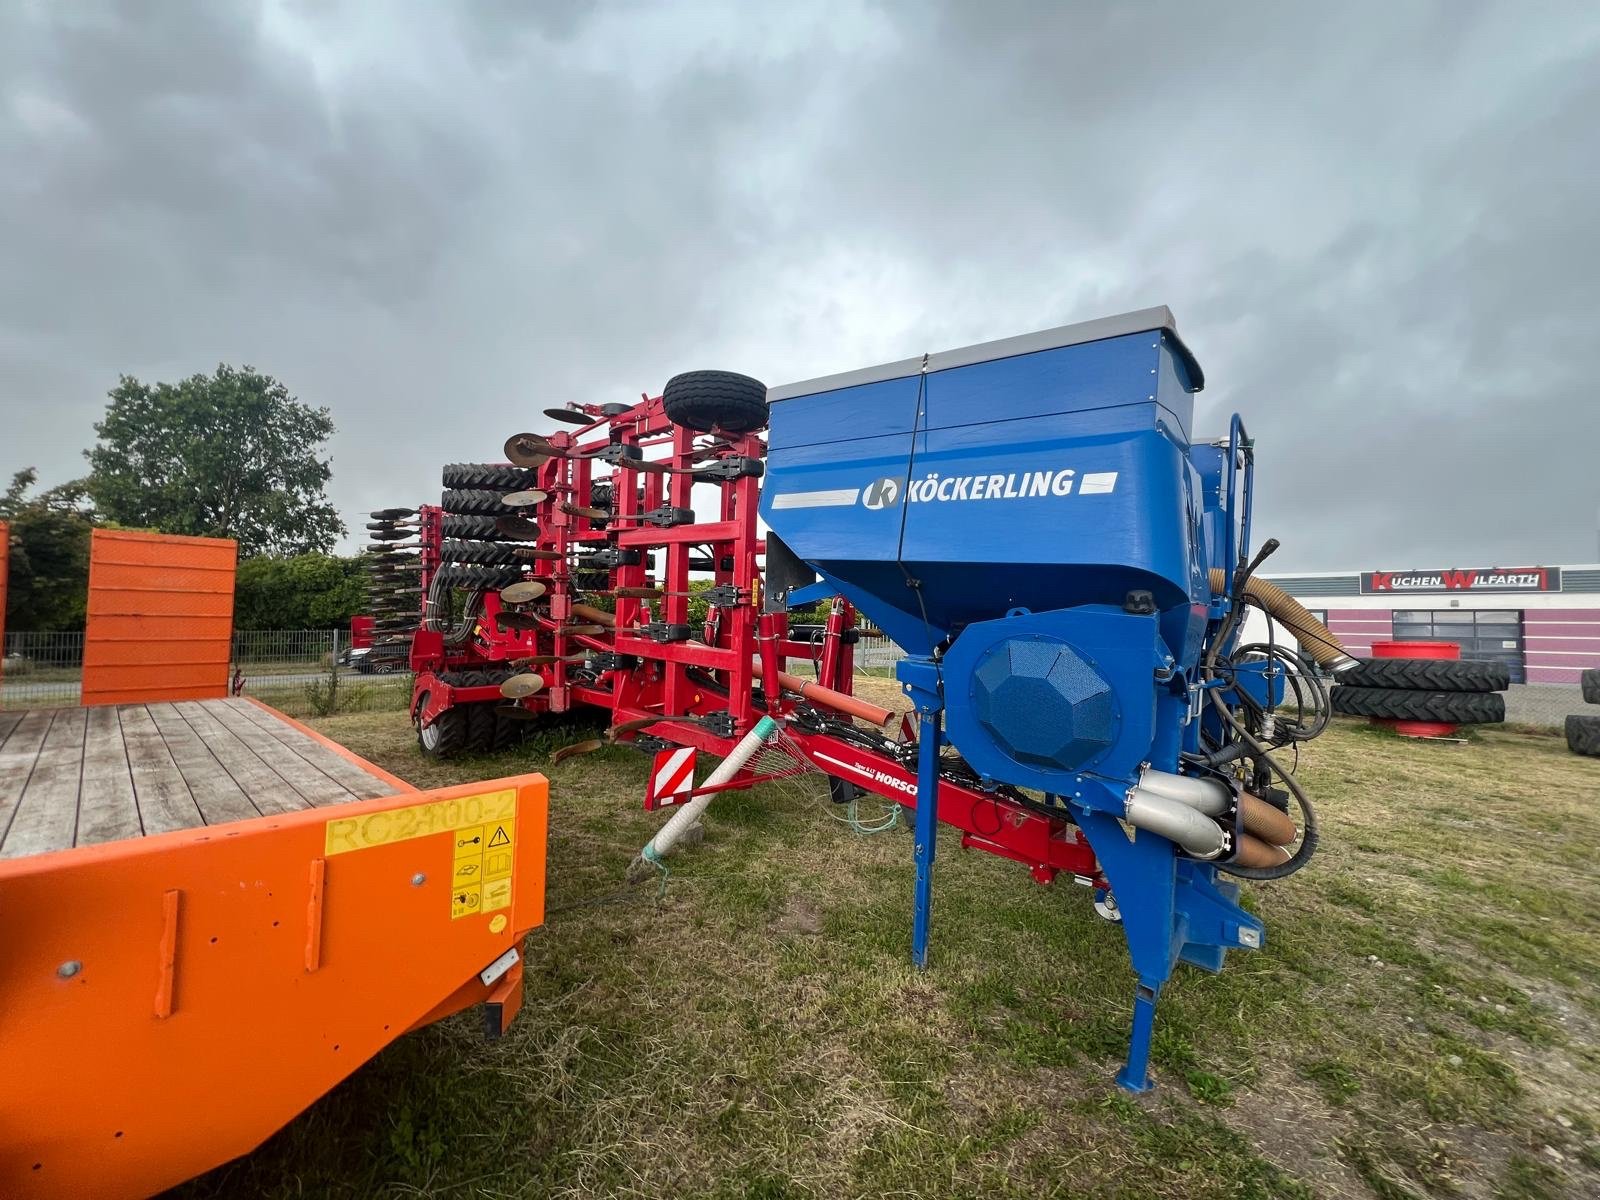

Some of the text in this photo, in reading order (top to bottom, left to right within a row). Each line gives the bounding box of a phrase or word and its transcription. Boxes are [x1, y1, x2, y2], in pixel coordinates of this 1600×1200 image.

[904, 470, 1075, 503] KÖCKERLING
[1372, 570, 1539, 590] KÜCHEN WILFARTH
